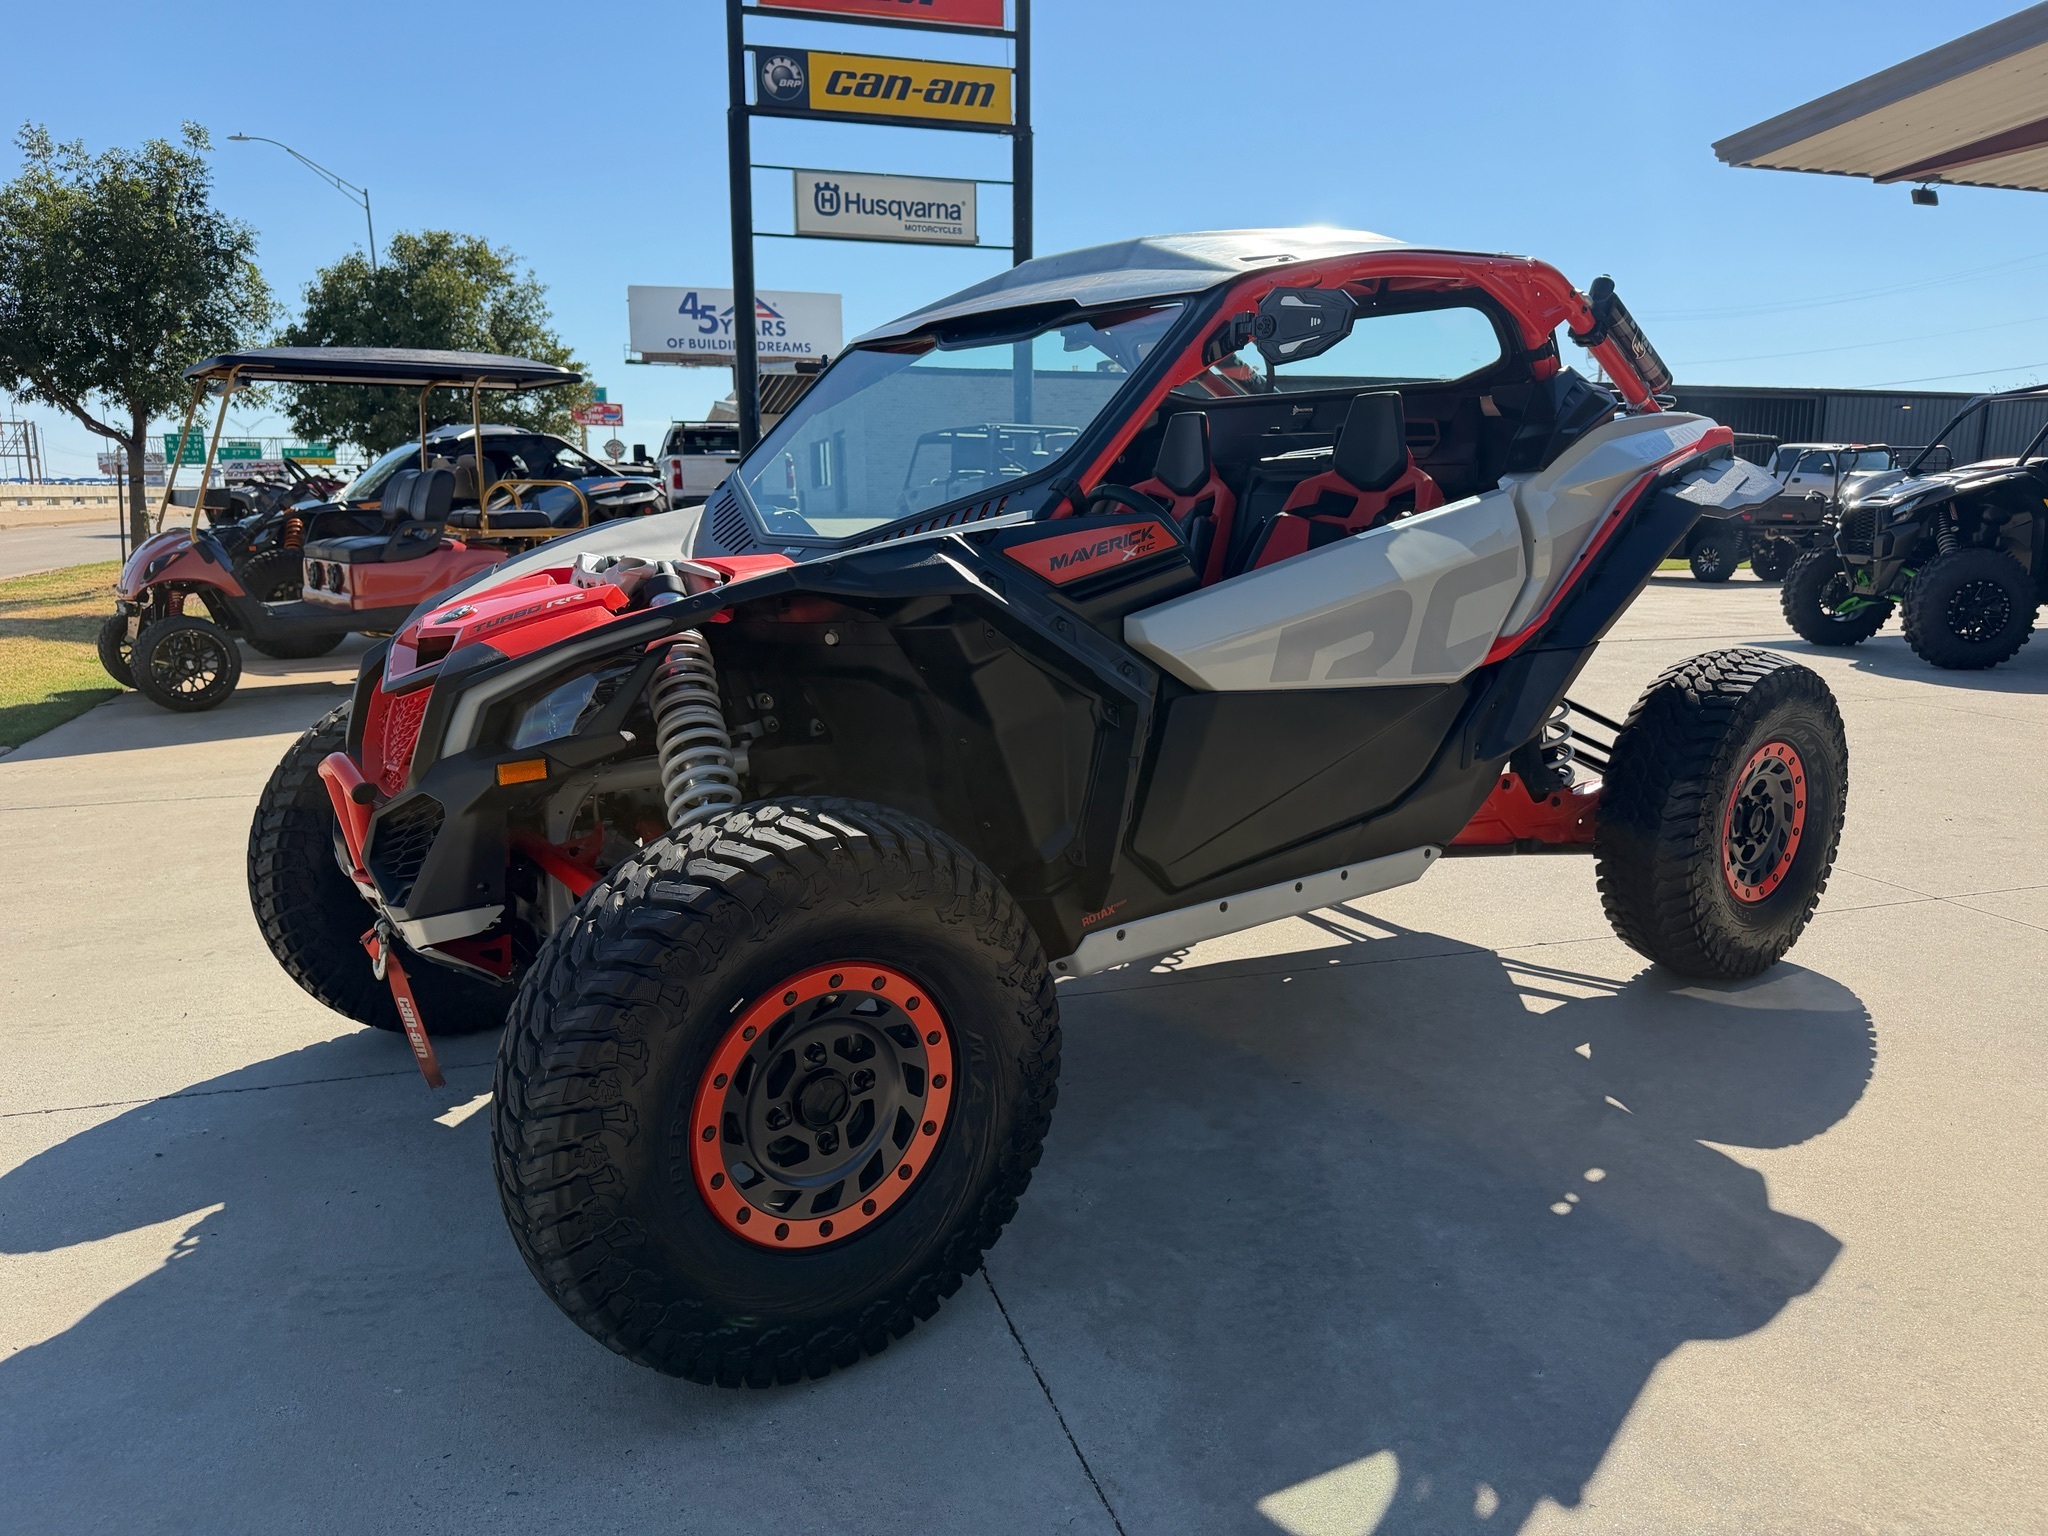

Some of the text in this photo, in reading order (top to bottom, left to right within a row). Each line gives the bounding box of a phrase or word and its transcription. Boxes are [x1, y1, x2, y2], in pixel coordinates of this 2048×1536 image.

[779, 78, 802, 88] BRP
[825, 70, 995, 108] can-am
[844, 192, 962, 221] Husqvarna
[904, 224, 963, 235] MOTORCYCLES
[678, 292, 787, 337] 45 YRS
[667, 338, 812, 353] OF BUILDI DREAMS
[1049, 525, 1156, 571] MAVERICK
[473, 593, 585, 632] TURBO RR
[1081, 904, 1116, 927] ROTAX
[397, 997, 429, 1059] can-am
